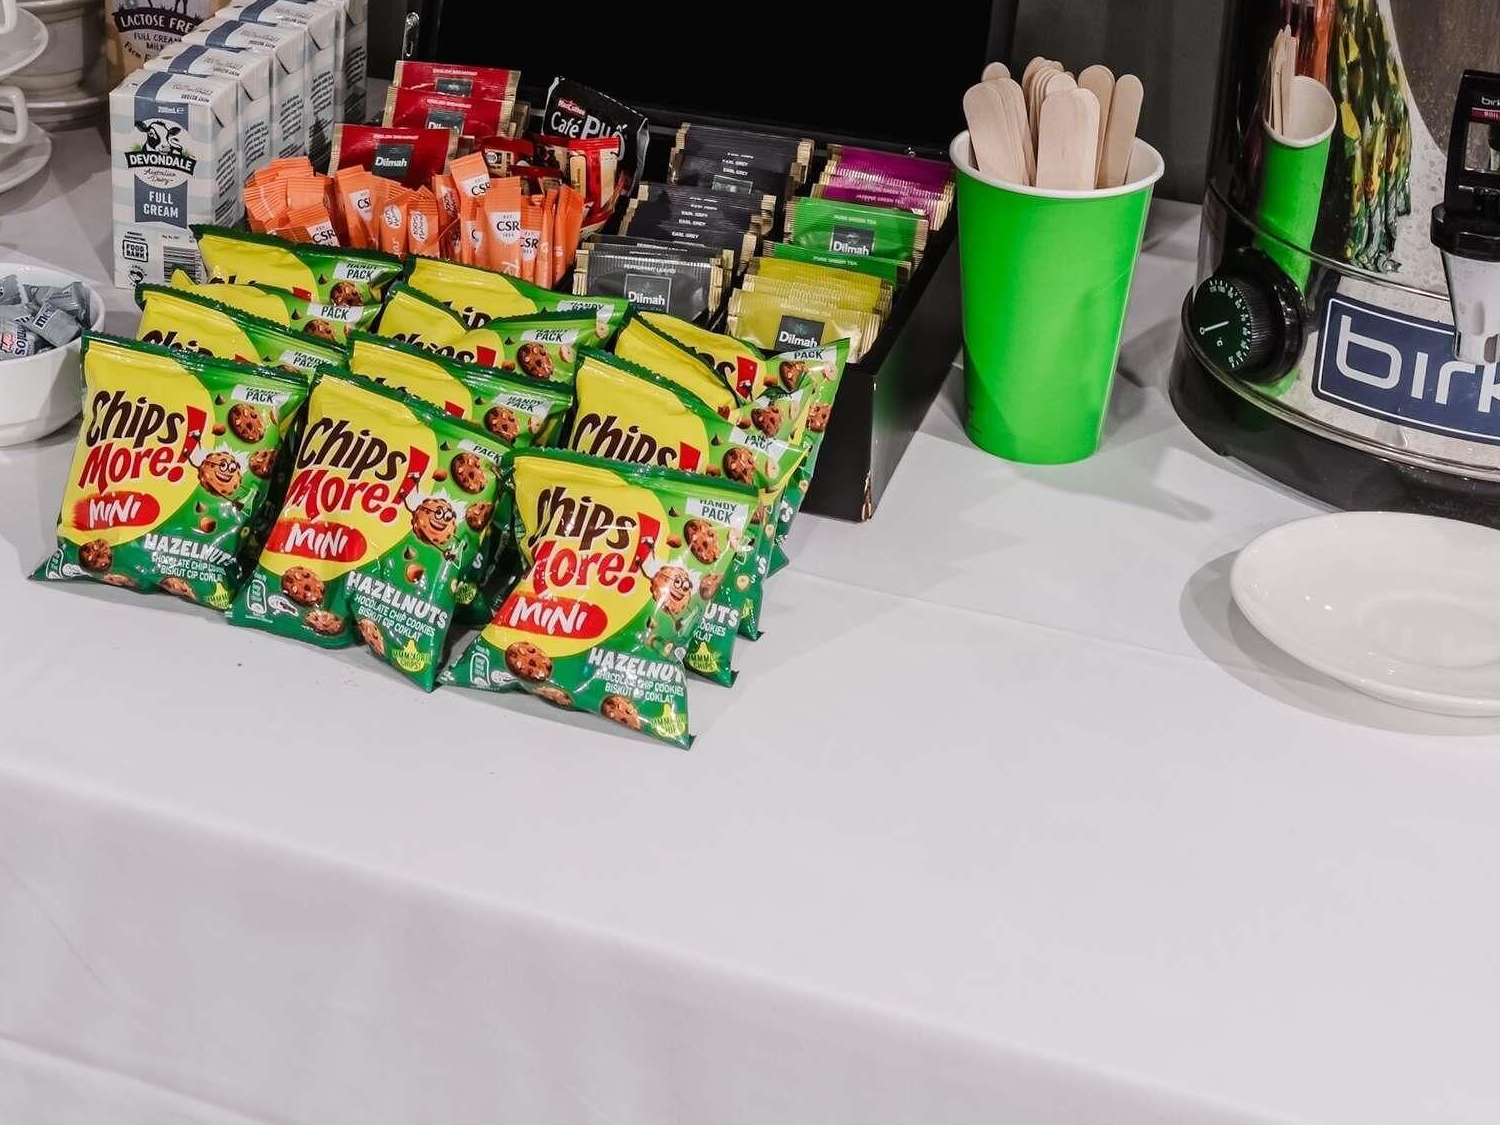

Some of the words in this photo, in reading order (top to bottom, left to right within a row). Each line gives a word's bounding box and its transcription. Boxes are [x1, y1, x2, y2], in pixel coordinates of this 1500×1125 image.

[120, 14, 165, 27] LACTOSE
[169, 18, 193, 33] FRE
[134, 32, 151, 41] FULL
[551, 111, 582, 138] Café
[130, 154, 194, 171] DEVONDALE
[374, 156, 407, 168] Dilmah
[149, 191, 173, 205] FULL
[357, 196, 371, 209] CS
[143, 204, 179, 218] CREAM
[496, 220, 521, 231] CSR
[312, 228, 336, 244] CSR
[126, 243, 145, 252] FOOD
[833, 241, 869, 255] Dilmah
[346, 268, 374, 281] PACK
[628, 291, 665, 306] Dilmah
[322, 306, 349, 320] PACK
[534, 331, 563, 342] PACK
[779, 331, 818, 347] Dilmah
[293, 356, 318, 369] PAC
[794, 349, 824, 360] PACK
[245, 391, 275, 403] PACK
[506, 400, 536, 412] PACK
[85, 389, 187, 449] Chips
[296, 417, 407, 481] Chips
[572, 413, 678, 469] Chips
[78, 405, 208, 494] More!
[472, 444, 501, 463] PACK
[284, 445, 430, 523] More!
[87, 493, 142, 527] MINI
[700, 499, 737, 512] HANDY
[702, 506, 733, 524] PACK
[284, 522, 349, 559] MINI
[143, 534, 238, 567] HAZELNUTS
[160, 565, 186, 577] BISKUT
[186, 568, 199, 579] CIP
[191, 560, 208, 571] CHIP
[346, 570, 448, 628] HAZELNUTS
[358, 606, 383, 624] BISKUT
[382, 618, 395, 629] CIP
[394, 623, 423, 641] COKLAT
[388, 607, 407, 622] CHIP
[406, 618, 436, 637] COOKIES
[510, 597, 587, 634] MINI
[588, 647, 684, 683] HAZELNUT
[605, 683, 632, 697] BISKUT
[645, 691, 674, 704] COKLAT
[637, 678, 655, 691] CHIP
[655, 683, 685, 697] COOKIES
